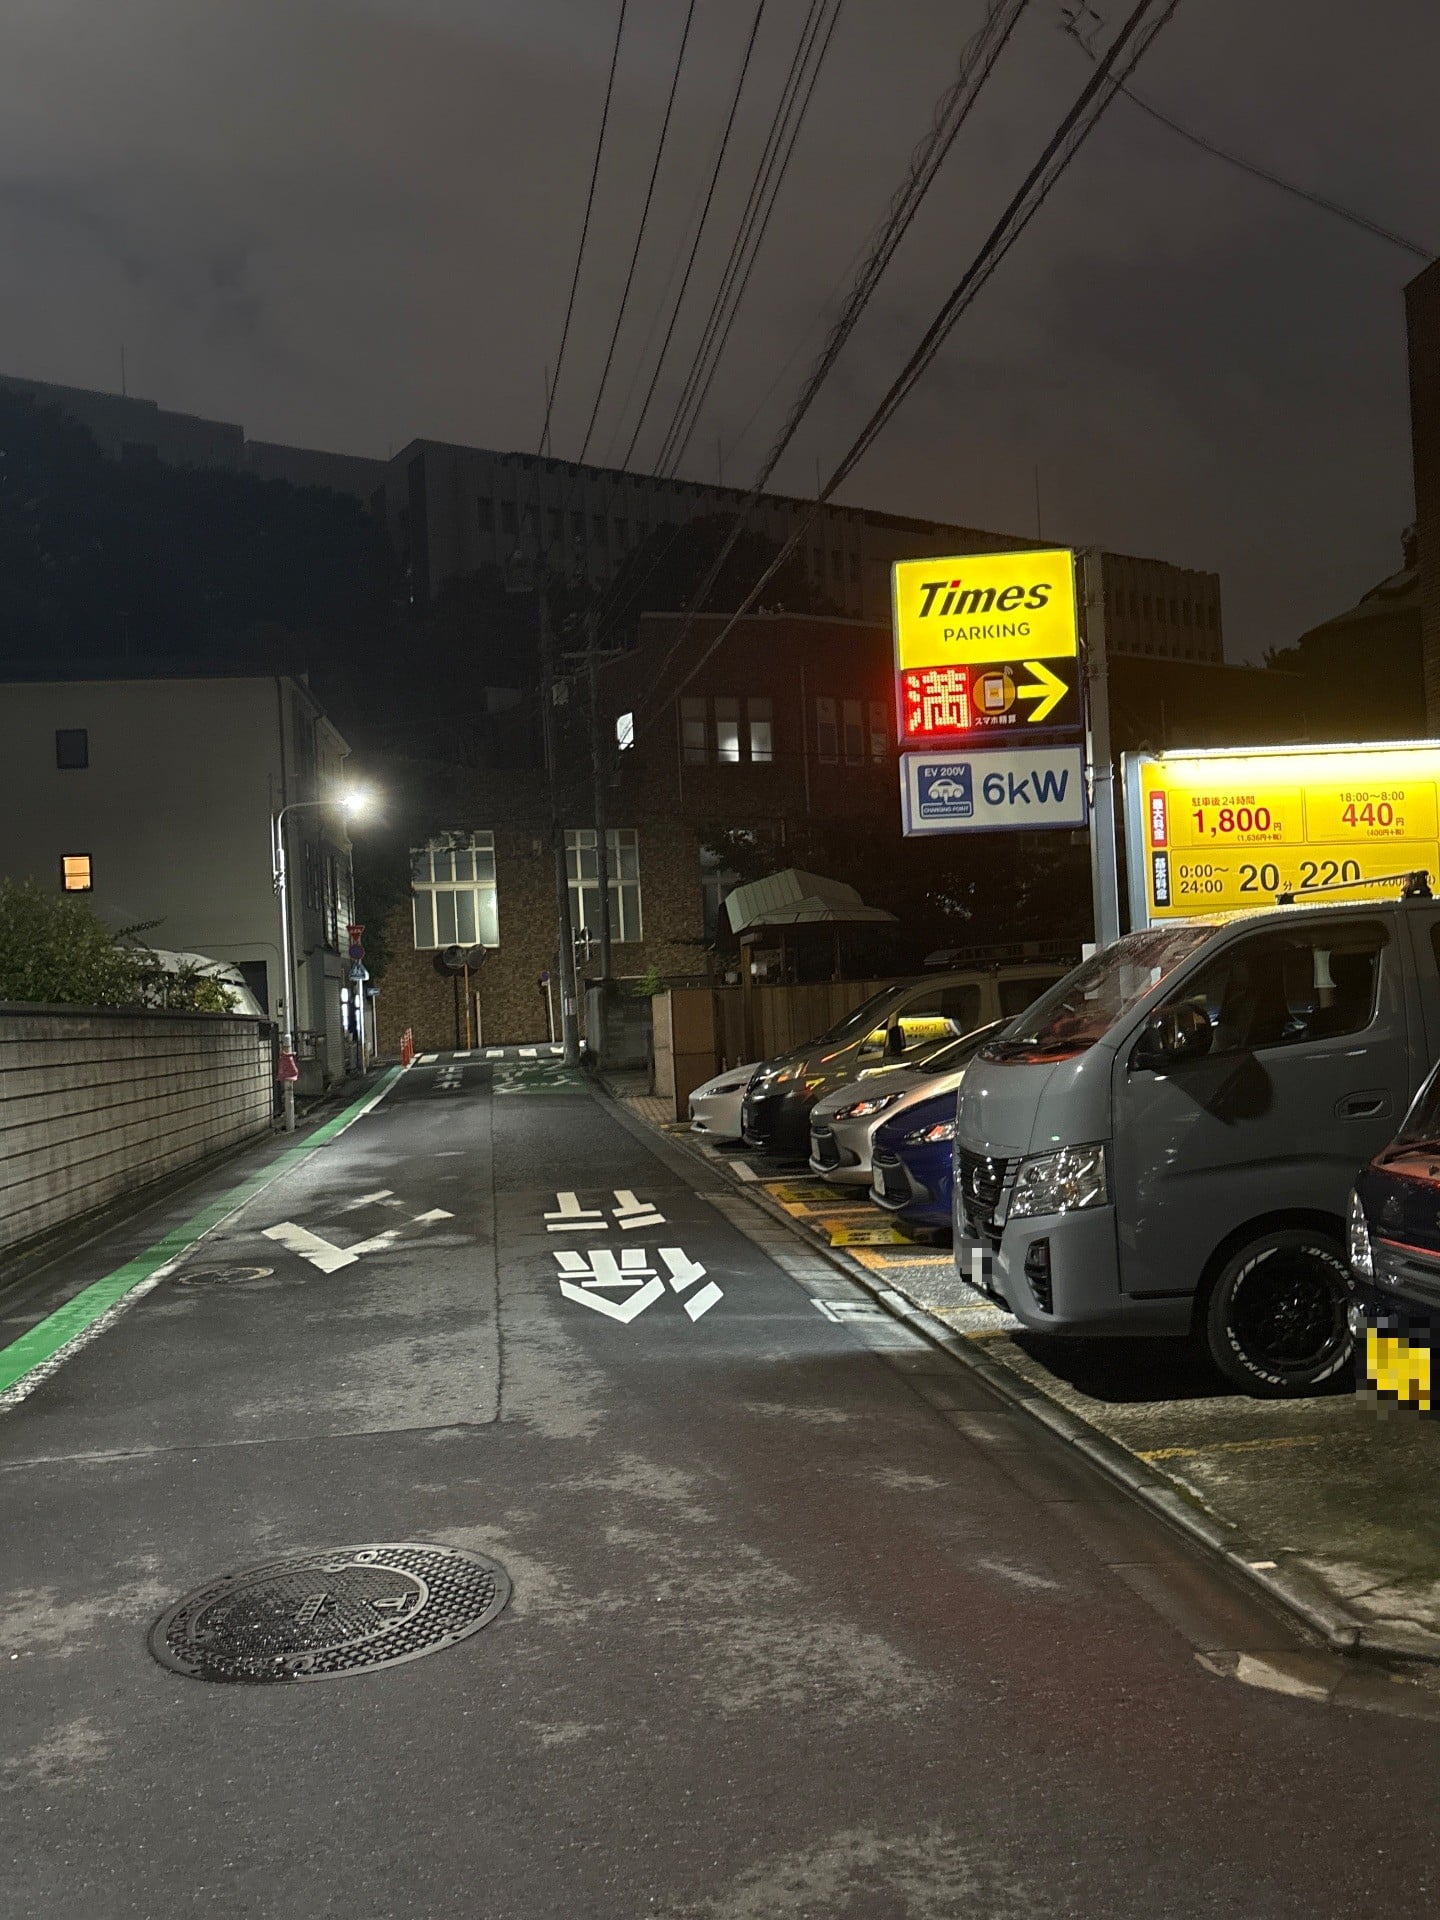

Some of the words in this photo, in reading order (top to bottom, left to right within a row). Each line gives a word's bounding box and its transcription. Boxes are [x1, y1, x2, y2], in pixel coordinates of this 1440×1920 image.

[918, 580, 1052, 618] Times
[943, 622, 1031, 642] PARKING
[907, 669, 969, 732] 満
[924, 767, 938, 777] EV
[940, 766, 965, 776] 200V
[982, 769, 1069, 806] 6kW
[1191, 795, 1256, 806] 駐車後24時間
[1180, 879, 1223, 894] 24:00
